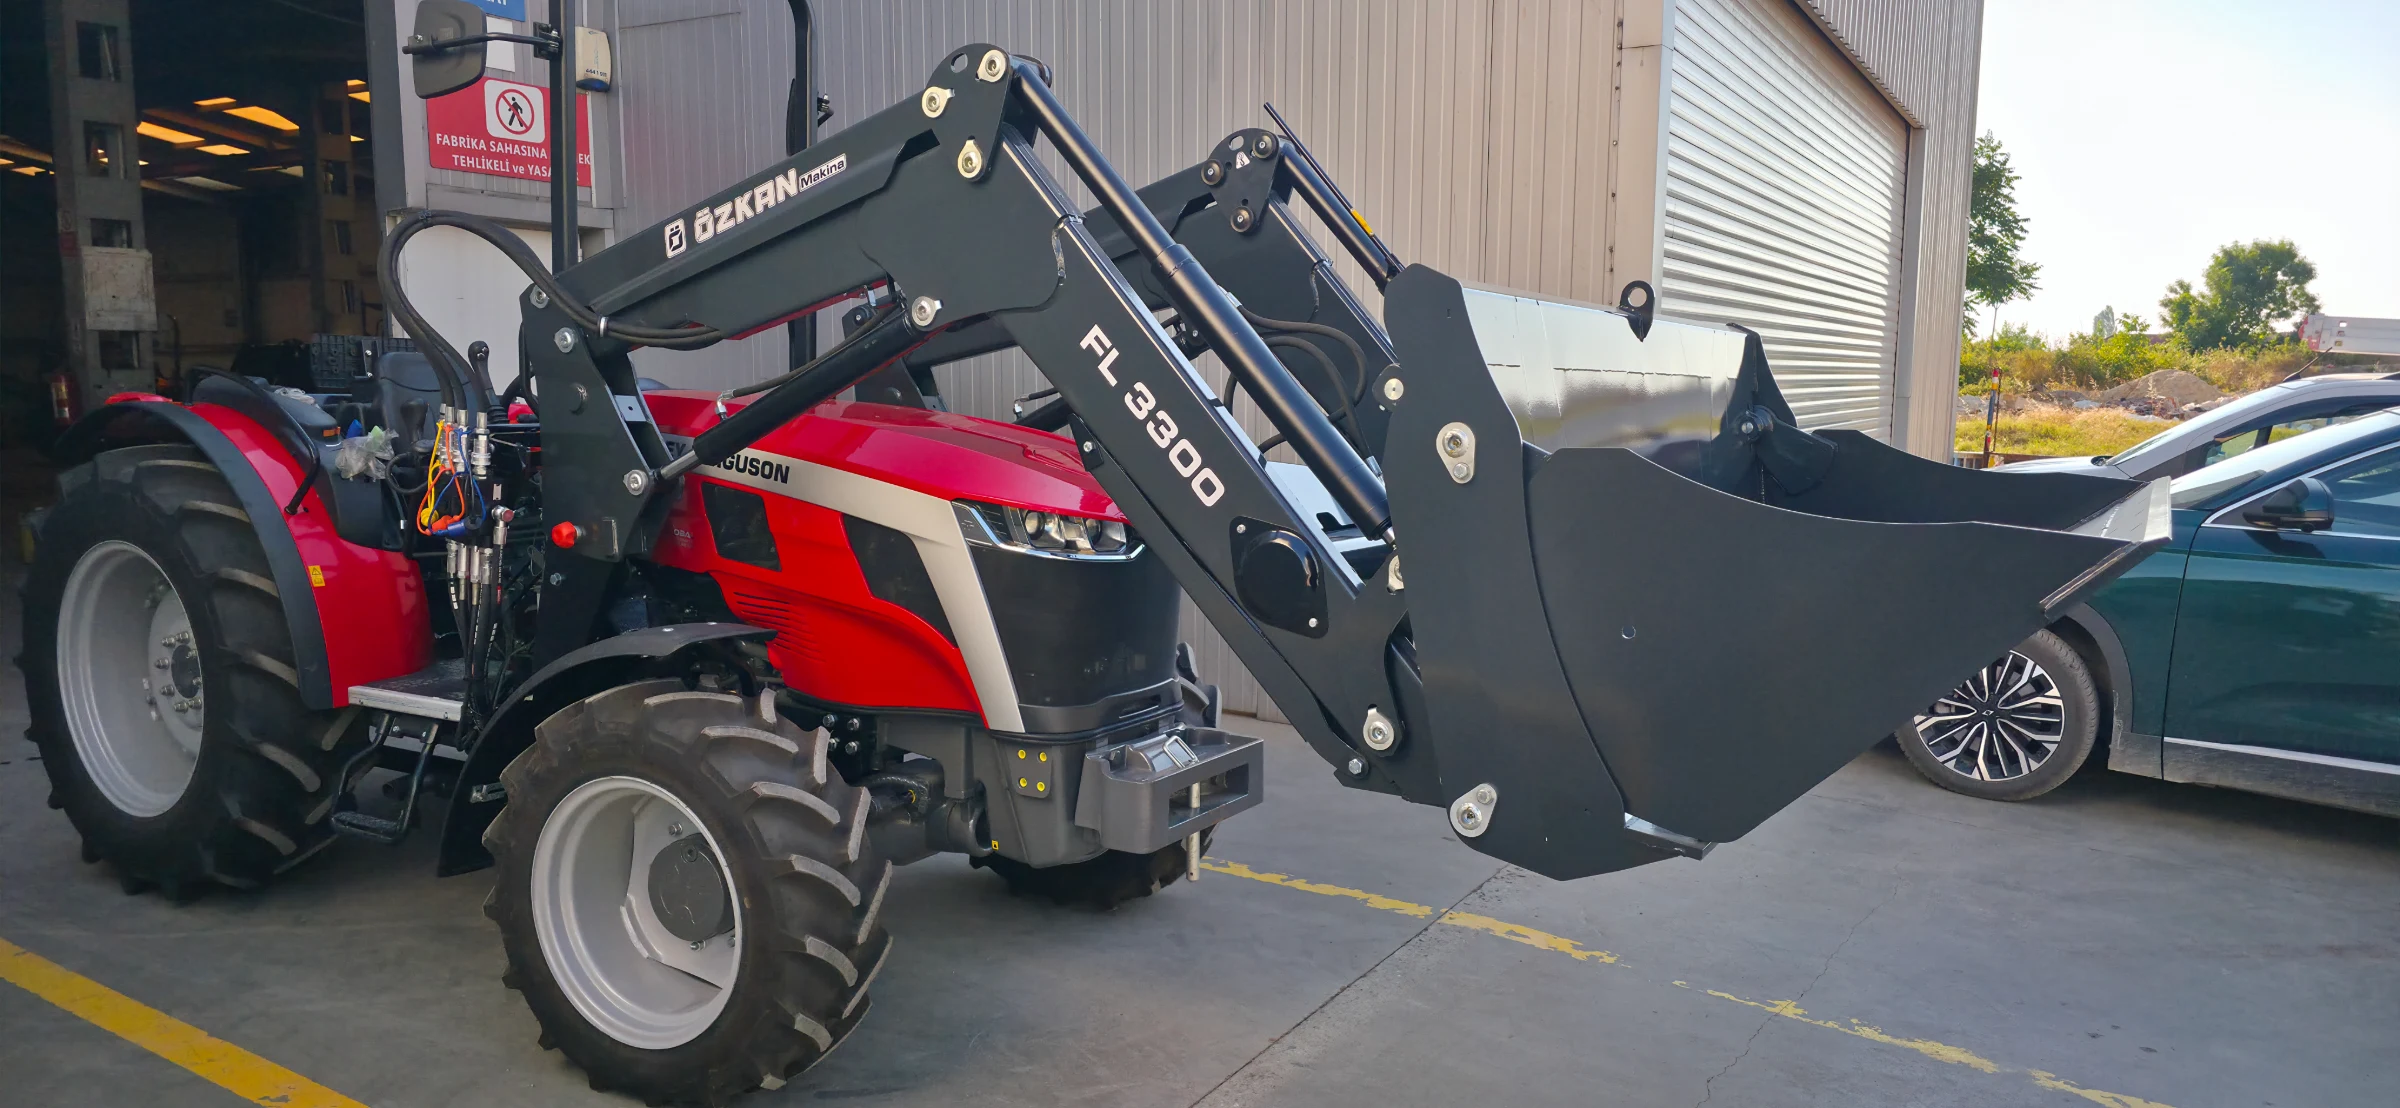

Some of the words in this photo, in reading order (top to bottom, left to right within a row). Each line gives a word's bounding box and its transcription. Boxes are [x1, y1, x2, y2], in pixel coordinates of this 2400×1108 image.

[436, 133, 487, 151] FABRİKA
[489, 141, 548, 160] SAHASINA
[452, 154, 510, 173] TEHLİKELİ
[512, 165, 525, 175] ve
[694, 167, 799, 244] ÖZKAN
[800, 157, 845, 190] Makina
[1079, 324, 1119, 387] FL
[1124, 381, 1225, 507] 3300
[717, 454, 790, 485] GUSON
